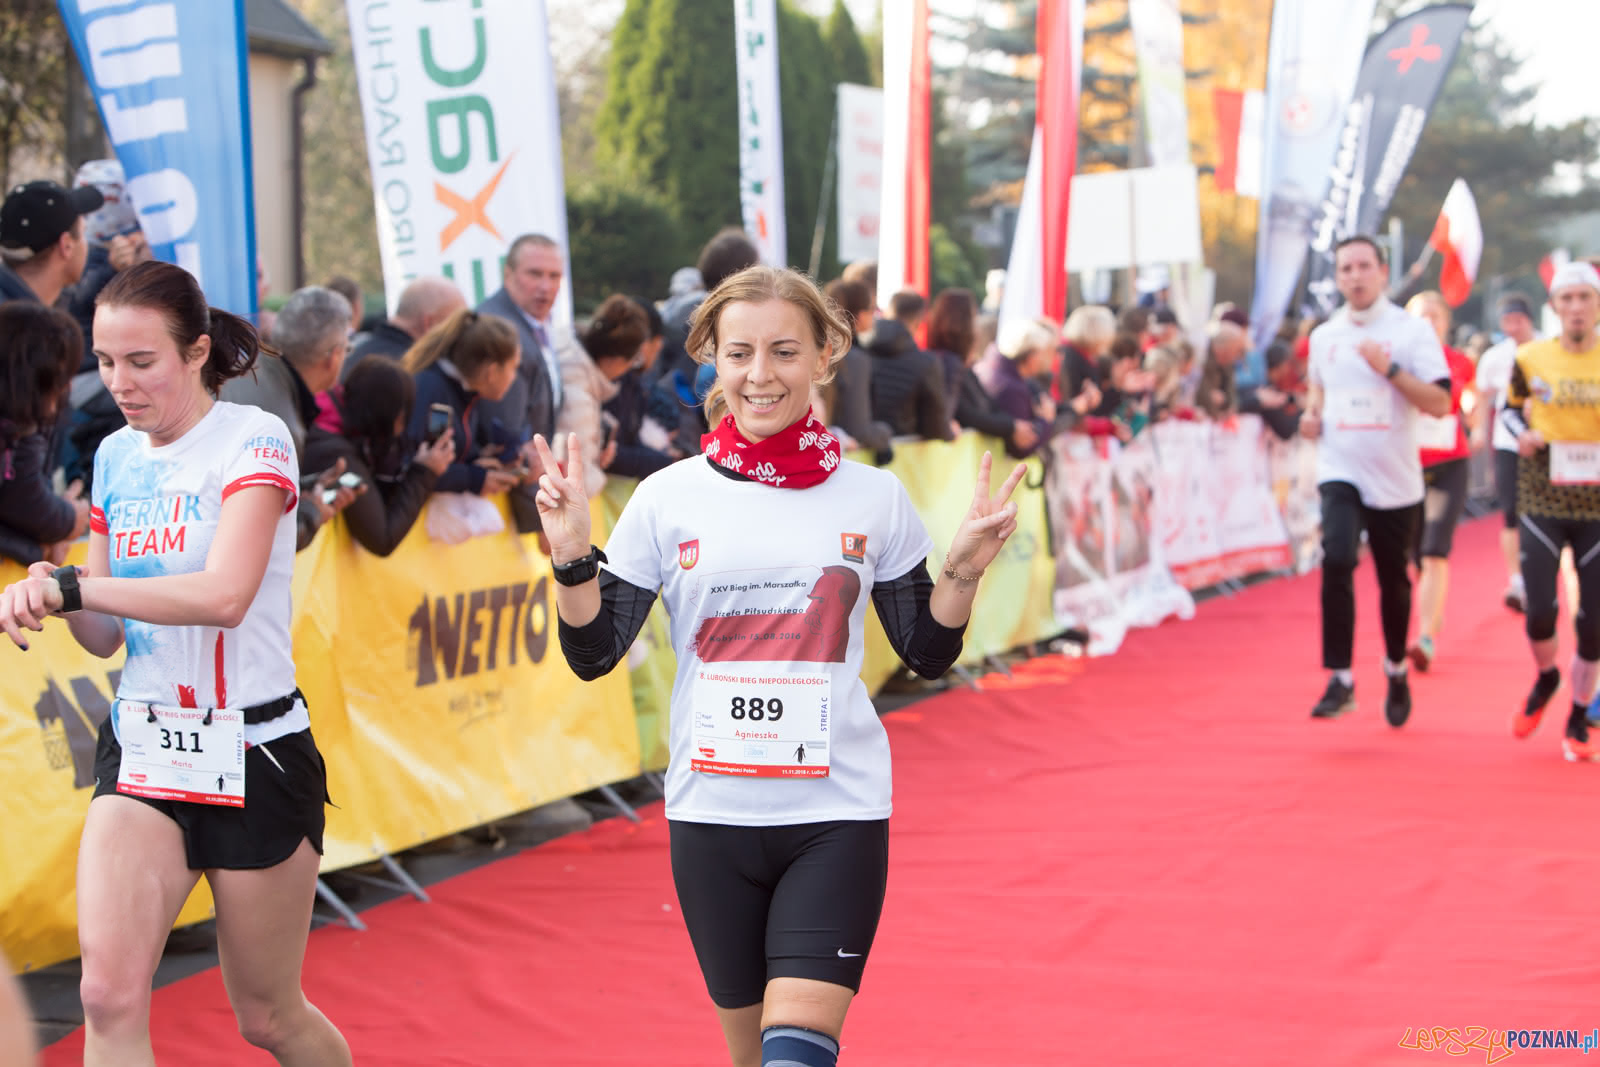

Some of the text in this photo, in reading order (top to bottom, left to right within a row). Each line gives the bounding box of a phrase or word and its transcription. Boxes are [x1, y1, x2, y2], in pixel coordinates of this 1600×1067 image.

[253, 447, 290, 465] TEAM
[109, 495, 203, 528] HERNIK
[115, 525, 186, 560] TEAM
[845, 536, 864, 553] BM
[710, 585, 728, 594] XXV
[729, 584, 748, 593] Bieg
[763, 580, 807, 589] Marszałka
[744, 606, 804, 616] Piłsudskiego
[435, 575, 549, 681] NETTO
[749, 632, 802, 641] 15.08.2016
[758, 677, 824, 685] NIEPODLEGŁOŚCI
[731, 696, 784, 722] 889
[820, 703, 828, 732] STREFA
[160, 728, 204, 753] 311
[735, 729, 779, 740] Agnieszka
[171, 759, 193, 769] Marta
